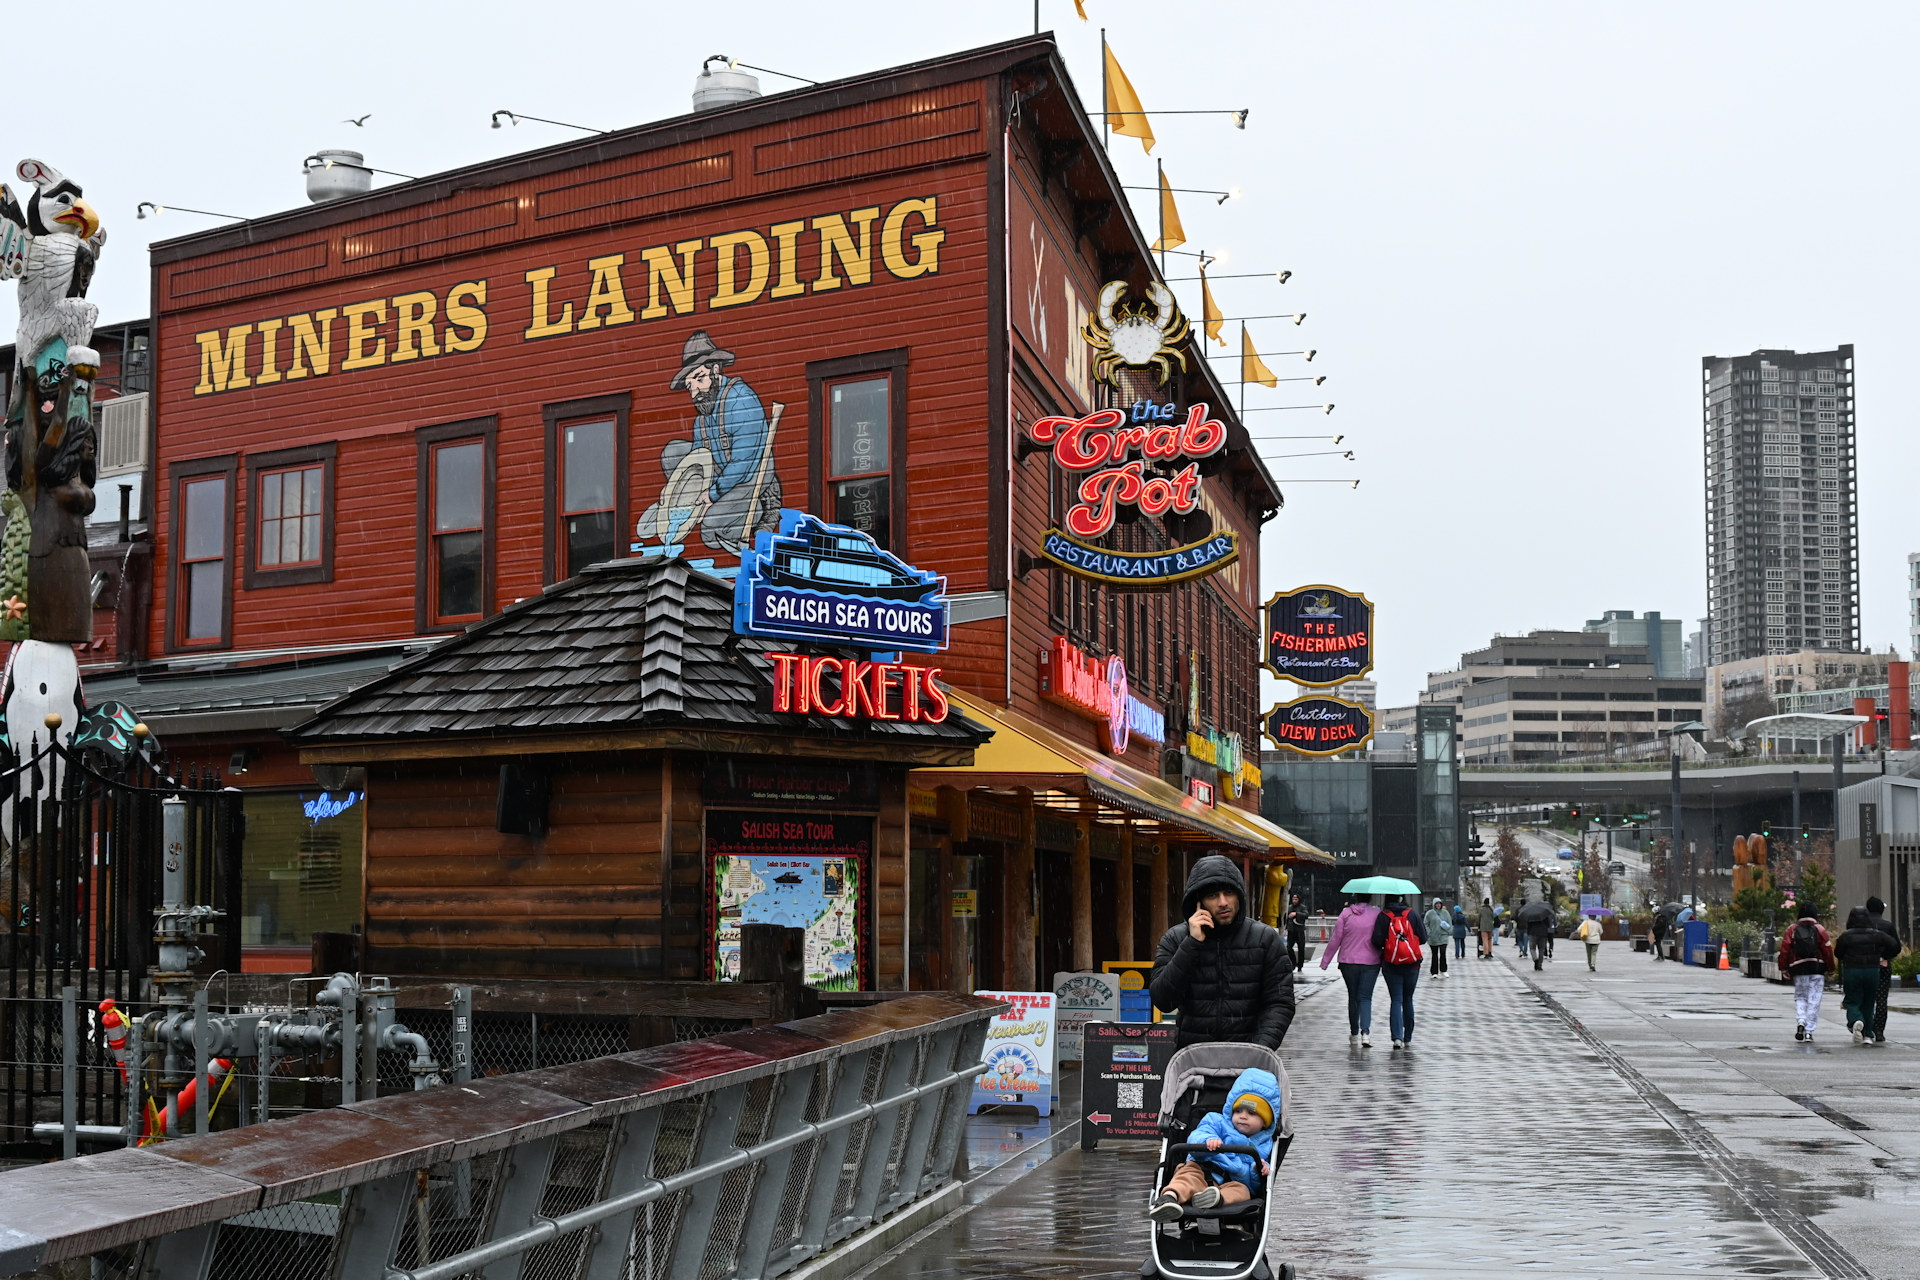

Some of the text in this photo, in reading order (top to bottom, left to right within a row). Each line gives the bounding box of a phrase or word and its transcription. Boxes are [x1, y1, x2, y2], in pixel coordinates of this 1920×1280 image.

[194, 195, 946, 396] MINERS LANDING
[1131, 399, 1177, 423] the
[852, 421, 873, 471] ICE
[1030, 402, 1227, 472] Crab
[1066, 460, 1202, 539] Pot
[1044, 536, 1233, 577] RESTAURANT & BAR
[765, 594, 933, 635] SALISH SEA TOURS
[1304, 622, 1336, 635] THE
[1271, 630, 1368, 653] FISHERMANS
[1277, 656, 1331, 669] Restaurant
[1341, 656, 1360, 668] Bar
[764, 651, 949, 724] TICKETS
[1290, 707, 1347, 721] Outdoor
[1280, 723, 1357, 741] VIEW DECK
[742, 821, 834, 840] SALISH SEA TOUR
[1056, 976, 1114, 1001] OYSTER
[1067, 998, 1100, 1007] BAR
[1126, 1027, 1142, 1037] Sea
[1126, 1064, 1137, 1072] THE
[979, 1073, 1040, 1093] Ice Cream
[1129, 1128, 1159, 1136] Departure
